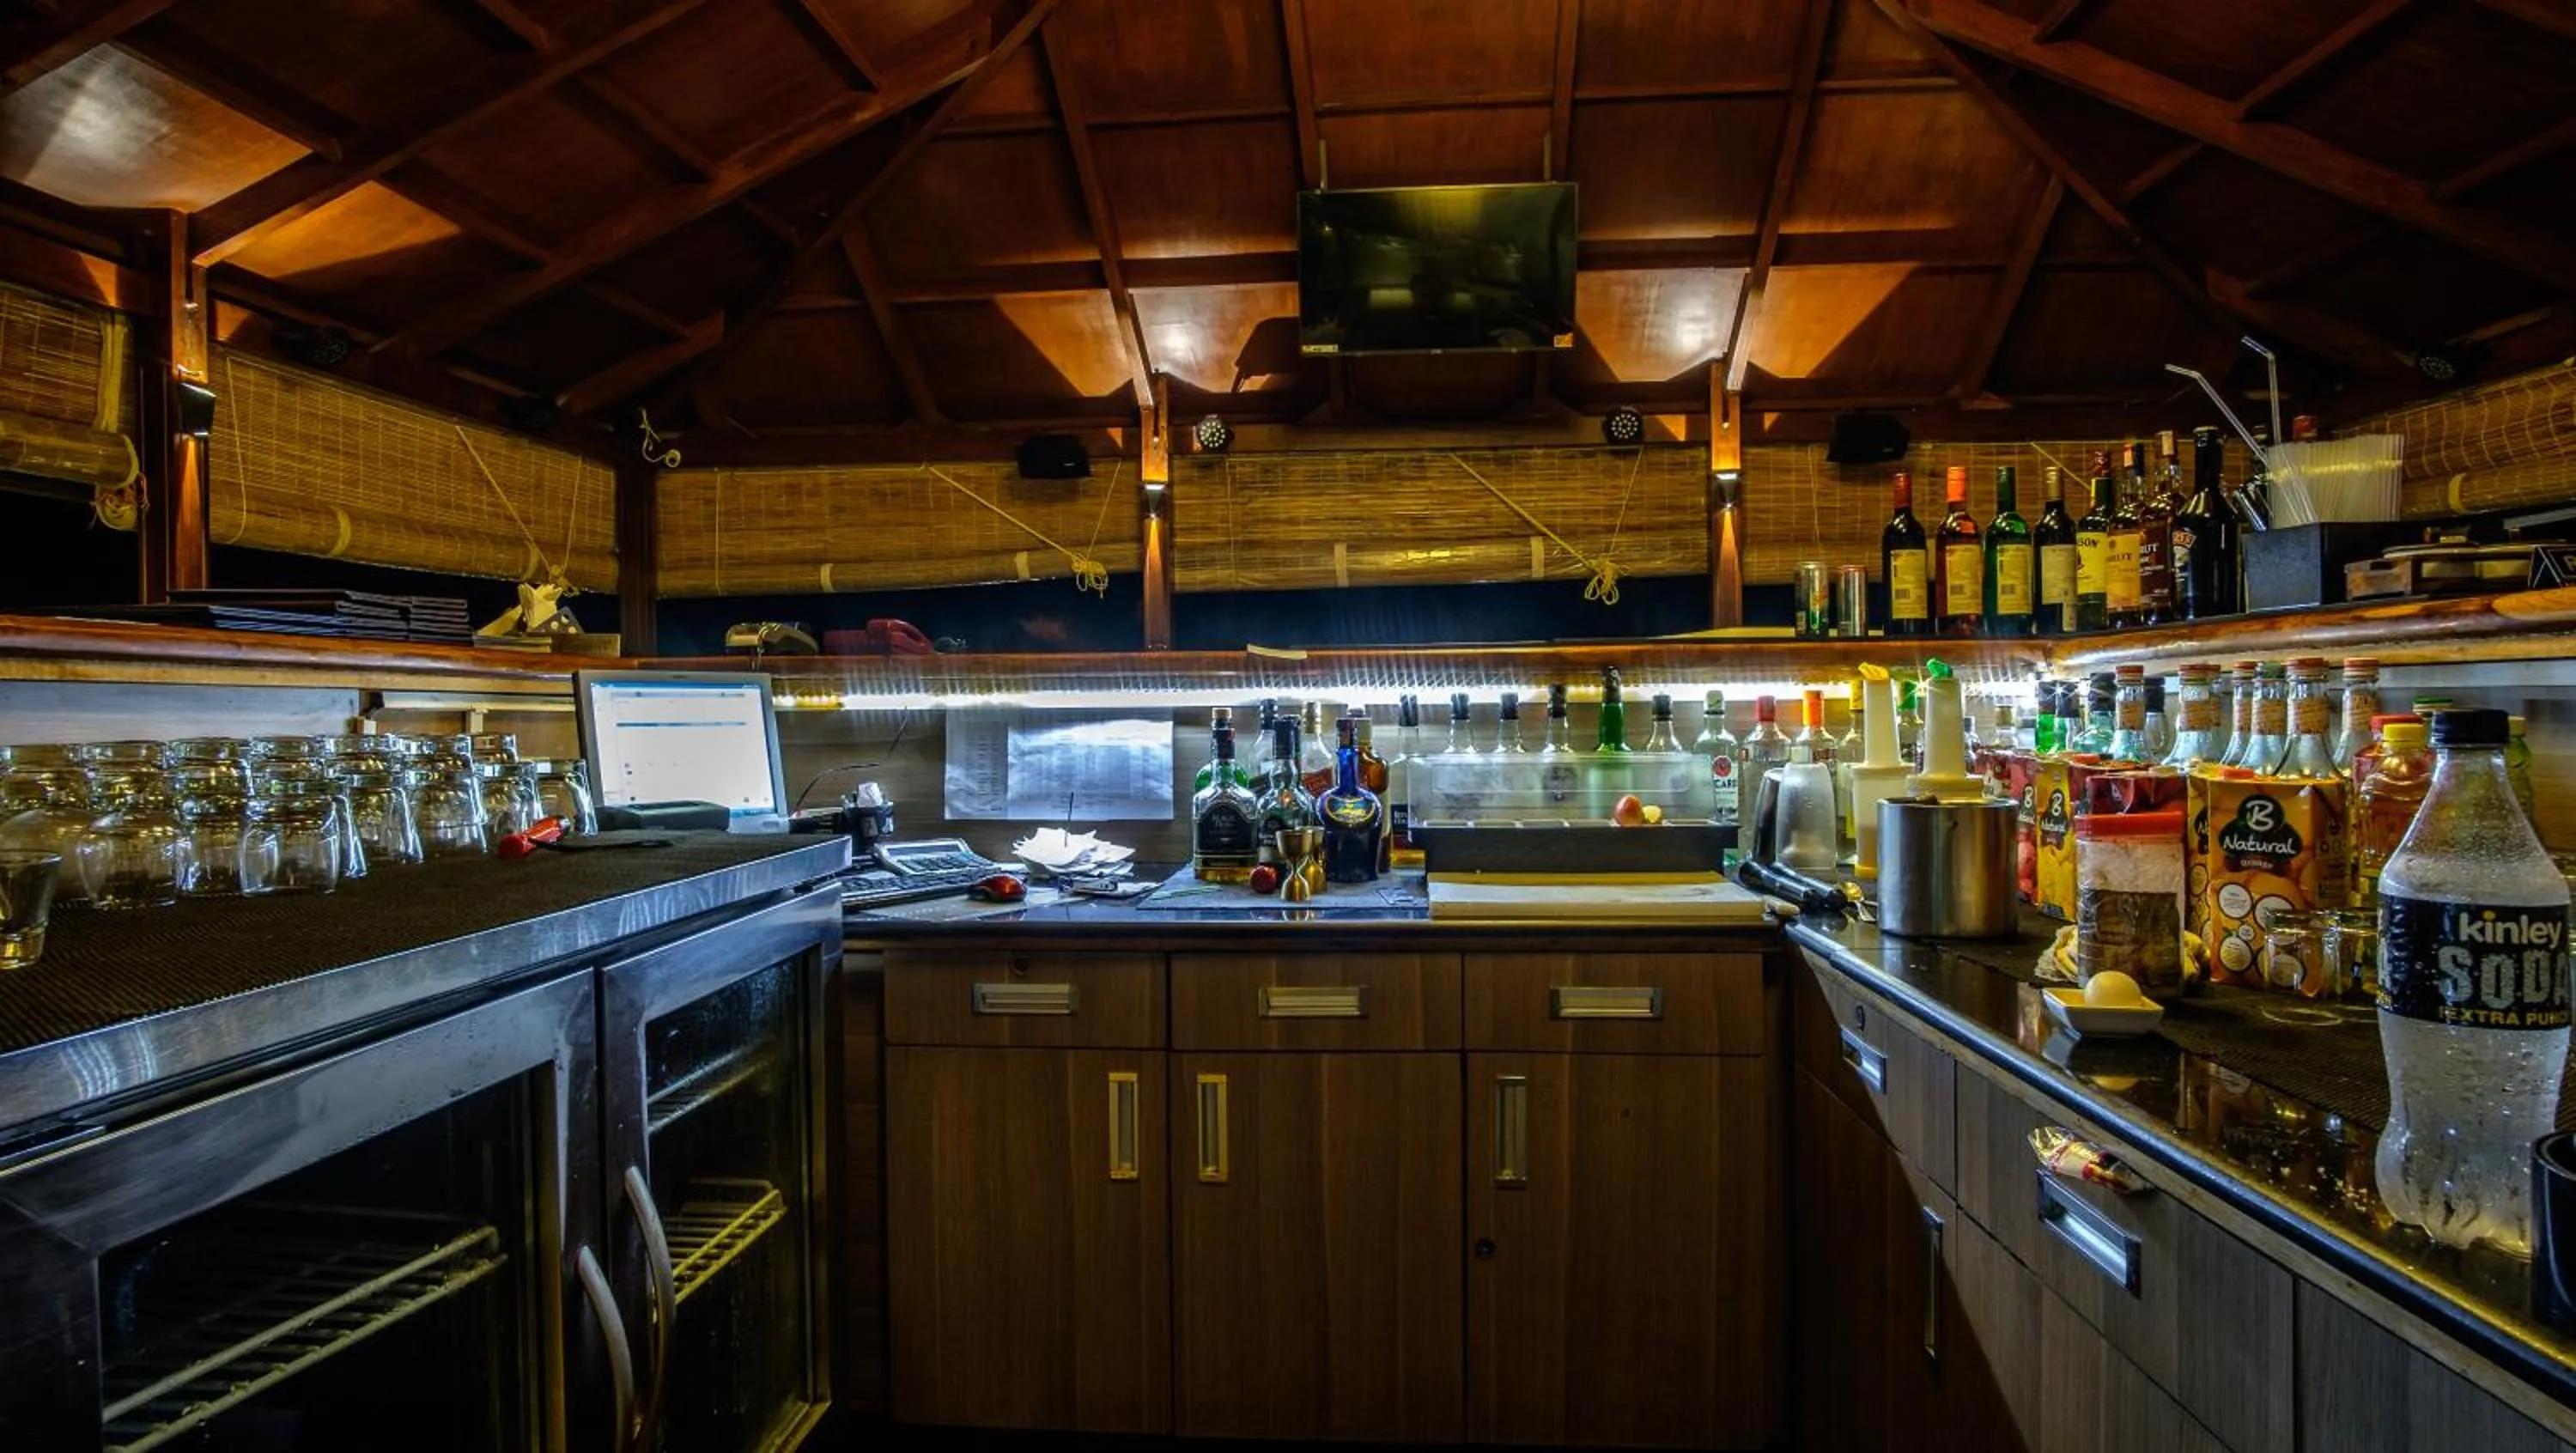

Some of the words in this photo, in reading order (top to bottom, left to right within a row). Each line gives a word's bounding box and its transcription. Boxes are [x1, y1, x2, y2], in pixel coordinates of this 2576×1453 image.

[2245, 799, 2275, 832] B
[2222, 834, 2297, 855] Natural
[2458, 909, 2563, 950] kinley
[2449, 1006, 2521, 1025] EXTRA
